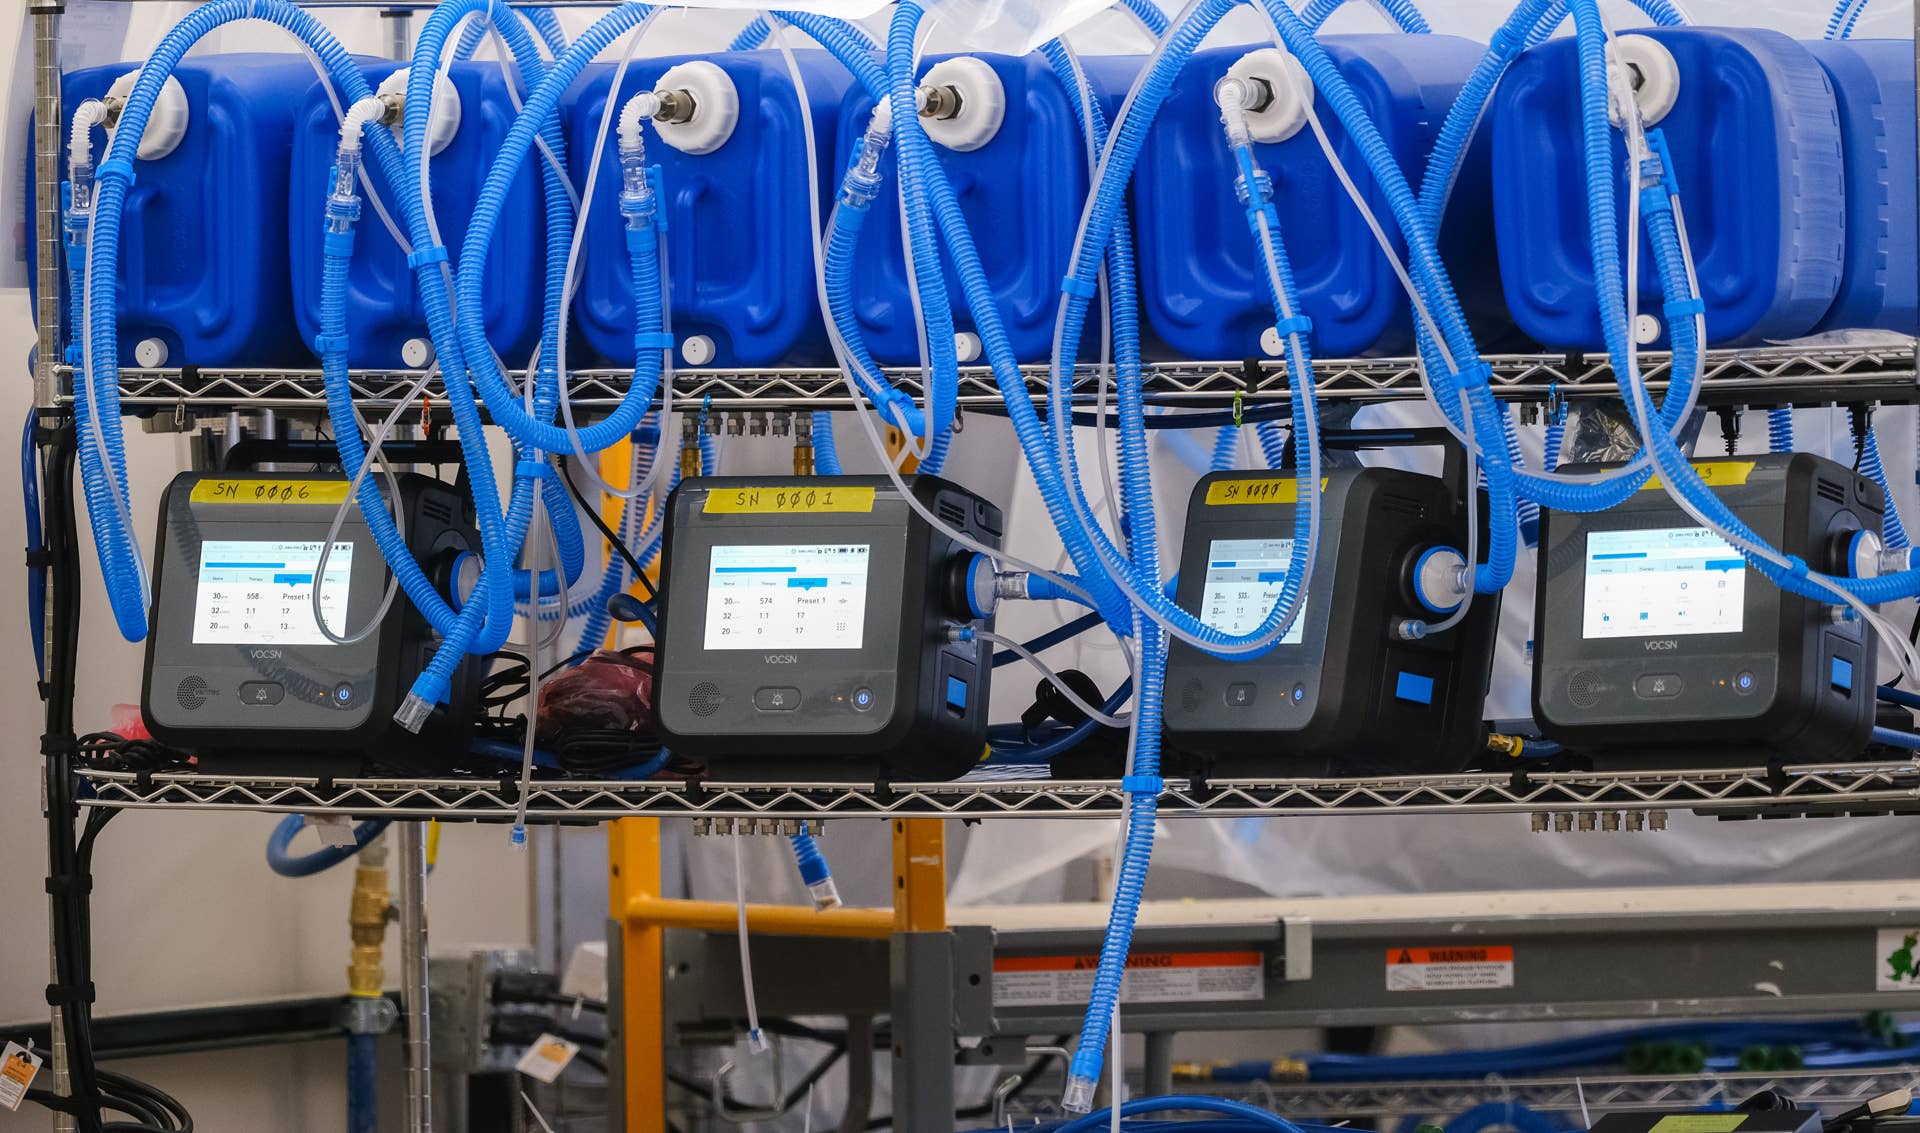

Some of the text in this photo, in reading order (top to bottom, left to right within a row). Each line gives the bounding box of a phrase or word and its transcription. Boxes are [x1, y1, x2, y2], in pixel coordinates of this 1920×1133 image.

[213, 482, 239, 500] SN
[1225, 484, 1239, 498] SN
[735, 492, 760, 507] SN
[212, 592, 221, 600] 30
[282, 592, 304, 601] Preset
[724, 597, 733, 605] 30
[797, 597, 820, 605] Preset
[211, 607, 220, 615] 32
[282, 607, 290, 615] 17
[723, 612, 732, 620] 32
[209, 622, 219, 630] 20
[280, 623, 288, 631] 13
[721, 627, 731, 635] 20
[795, 627, 804, 635] 17
[1644, 640, 1678, 651] VOCSN
[250, 649, 282, 659] VOCSN
[764, 655, 797, 664] VOCSN
[1086, 955, 1173, 969] WNING
